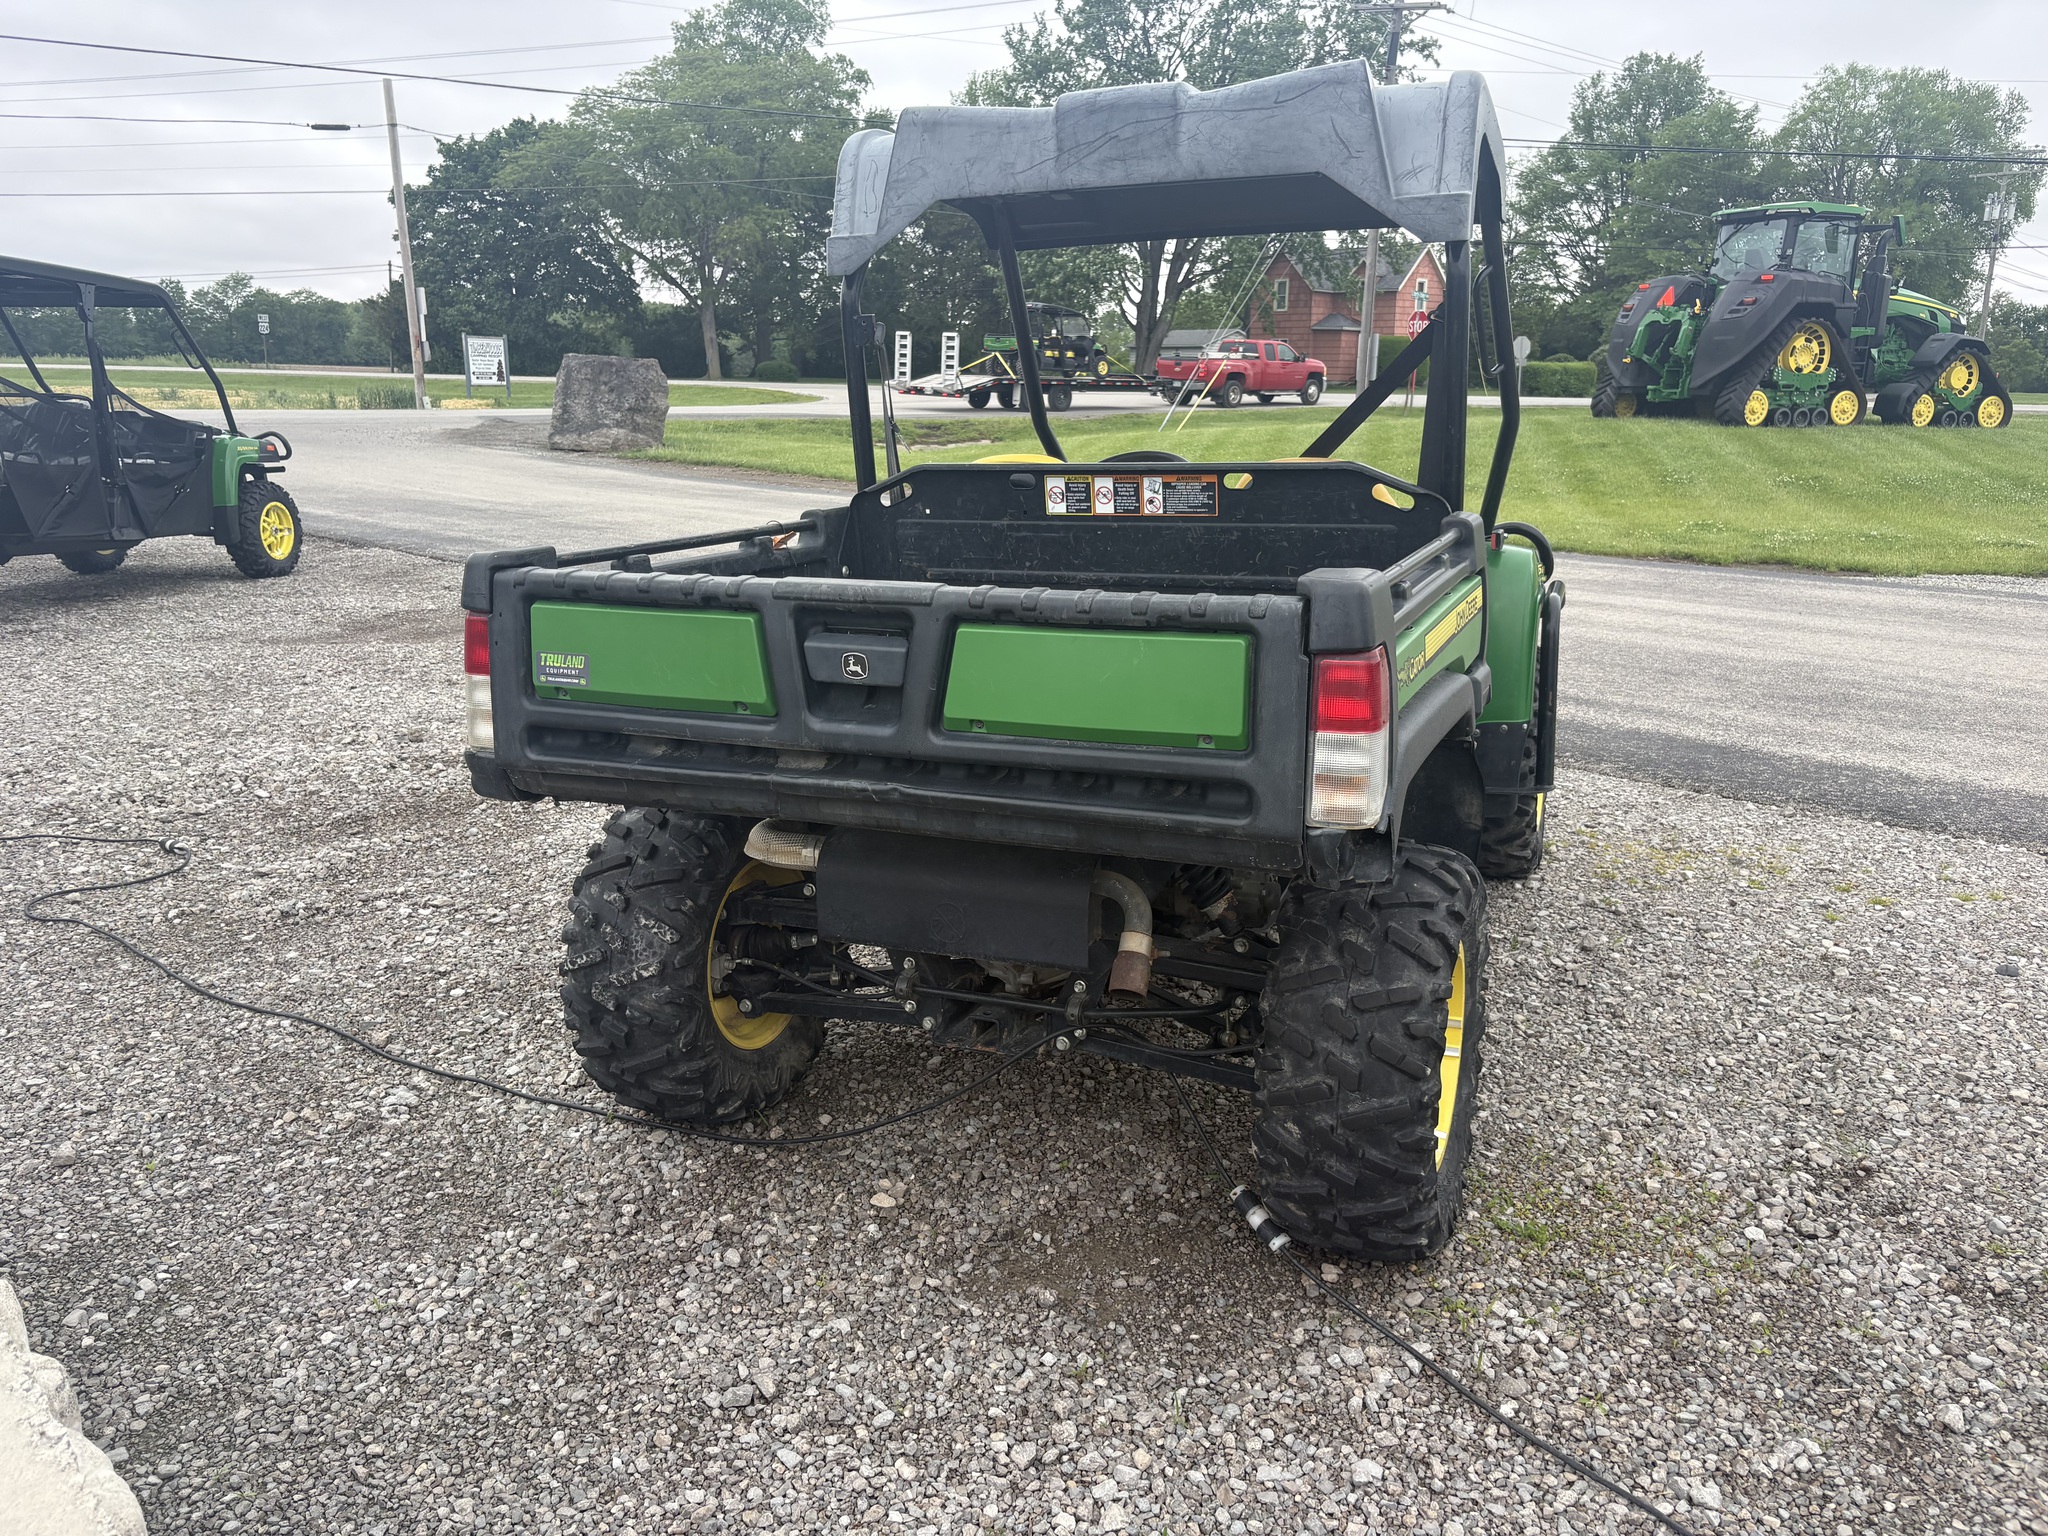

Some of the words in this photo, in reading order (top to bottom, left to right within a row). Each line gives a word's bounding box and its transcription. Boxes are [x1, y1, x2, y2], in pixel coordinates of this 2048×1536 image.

[260, 324, 269, 332] 224
[1408, 320, 1429, 333] STOP
[1465, 596, 1478, 622] DEERE
[540, 653, 585, 668] TRULAND
[1409, 650, 1424, 680] GATOR
